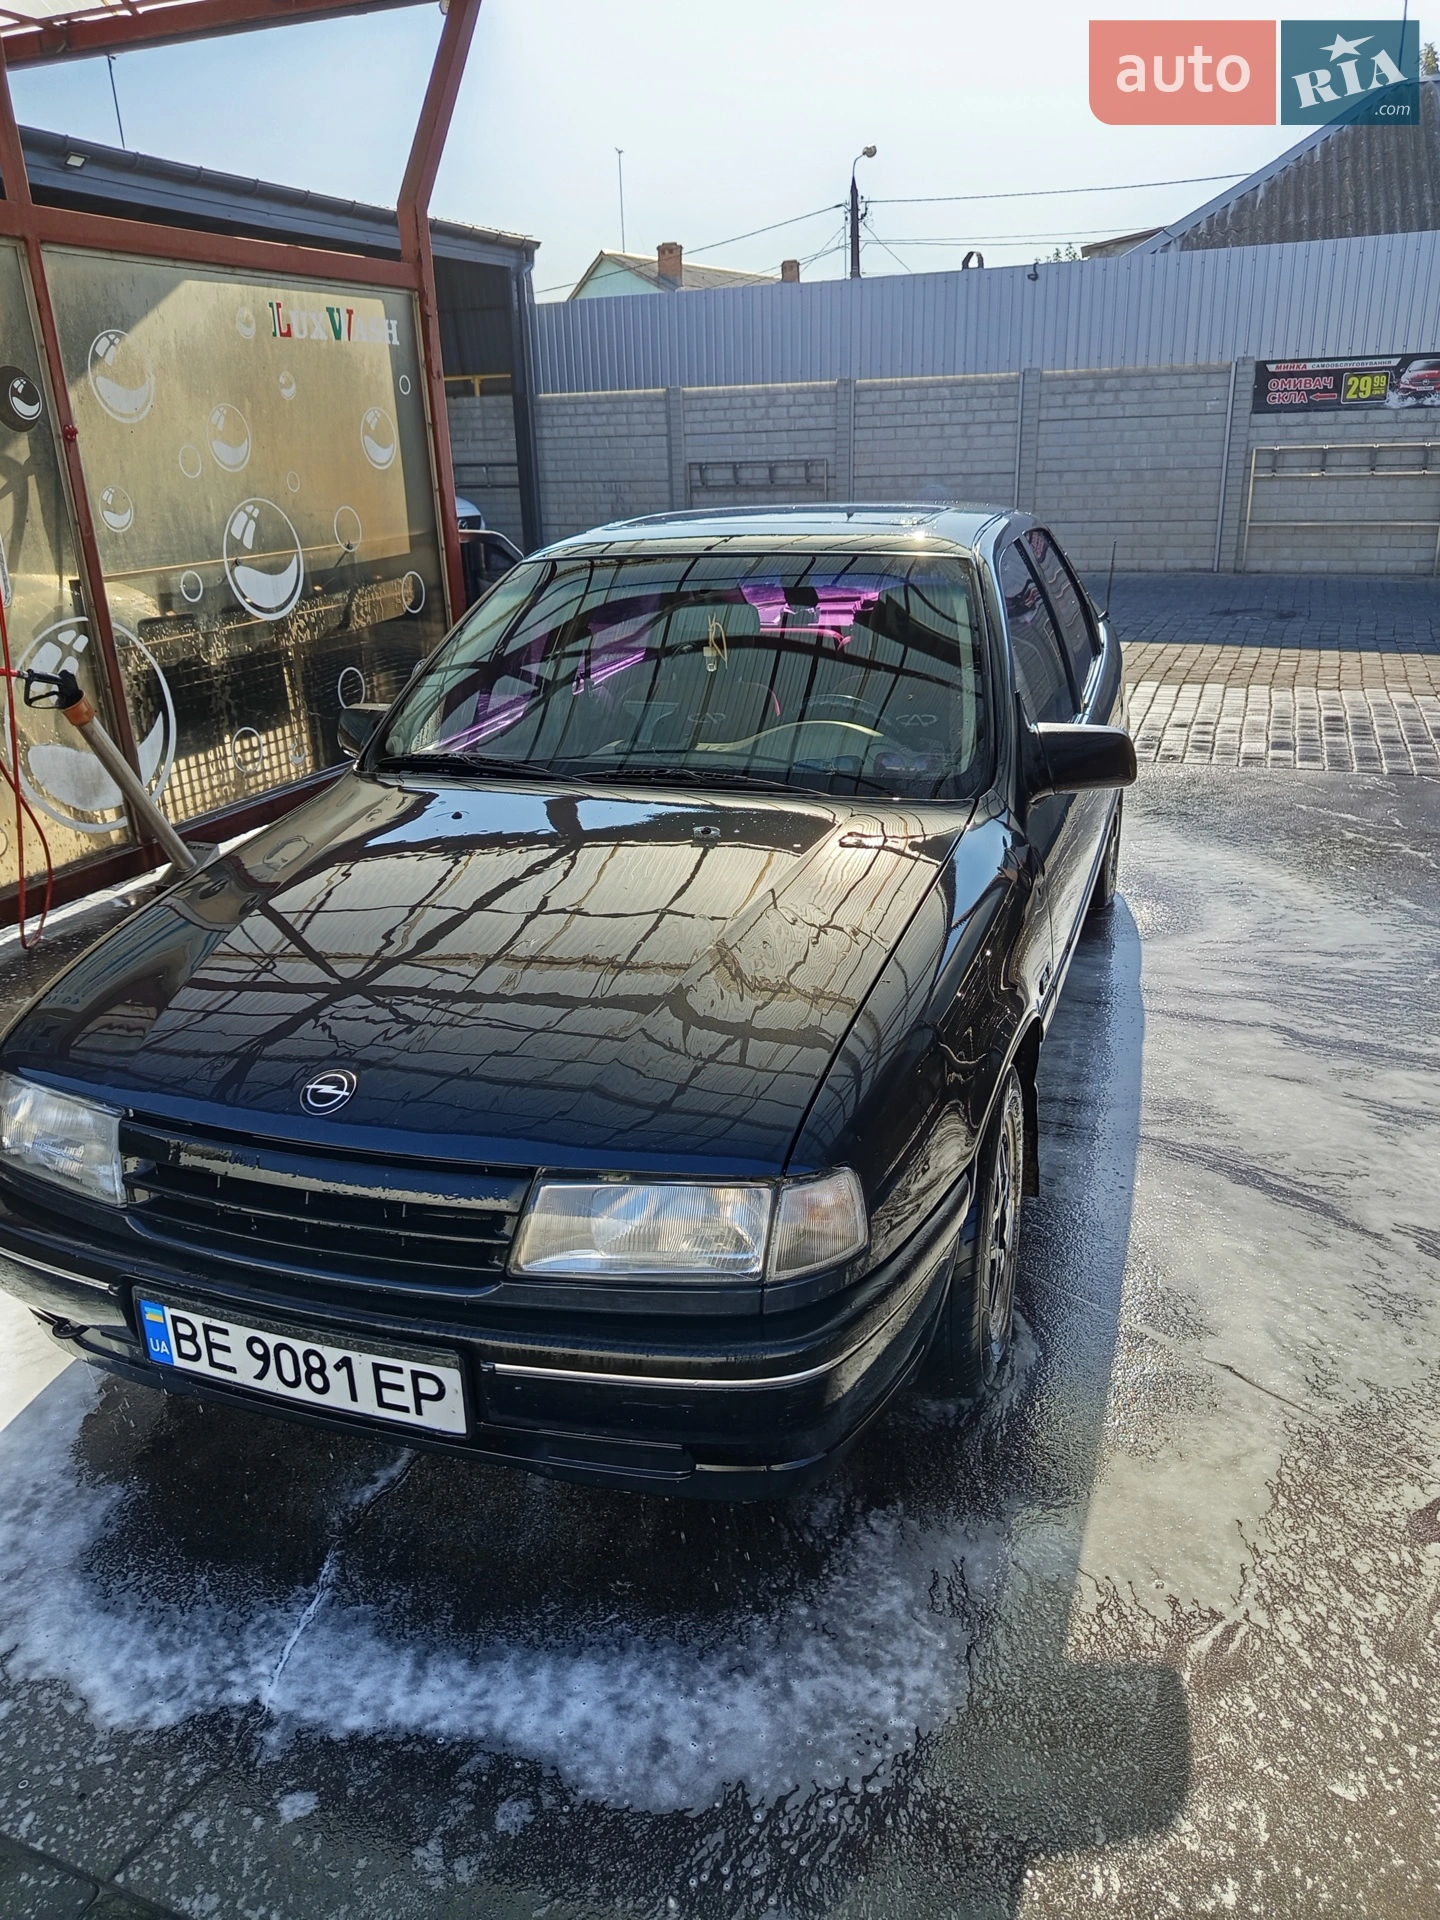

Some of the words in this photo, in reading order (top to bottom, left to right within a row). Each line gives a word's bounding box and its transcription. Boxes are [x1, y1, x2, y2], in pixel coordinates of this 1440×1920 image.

[1275, 363, 1308, 371] МИЙКА
[1311, 360, 1392, 369] САМООБСЛУГОВУВАННЯ
[1268, 376, 1334, 391] ОМИВАЧ
[1266, 391, 1308, 405] СКЛА
[150, 1337, 171, 1356] UA
[170, 1314, 238, 1375] BE
[245, 1335, 358, 1403] 9081
[371, 1361, 446, 1416] EP
